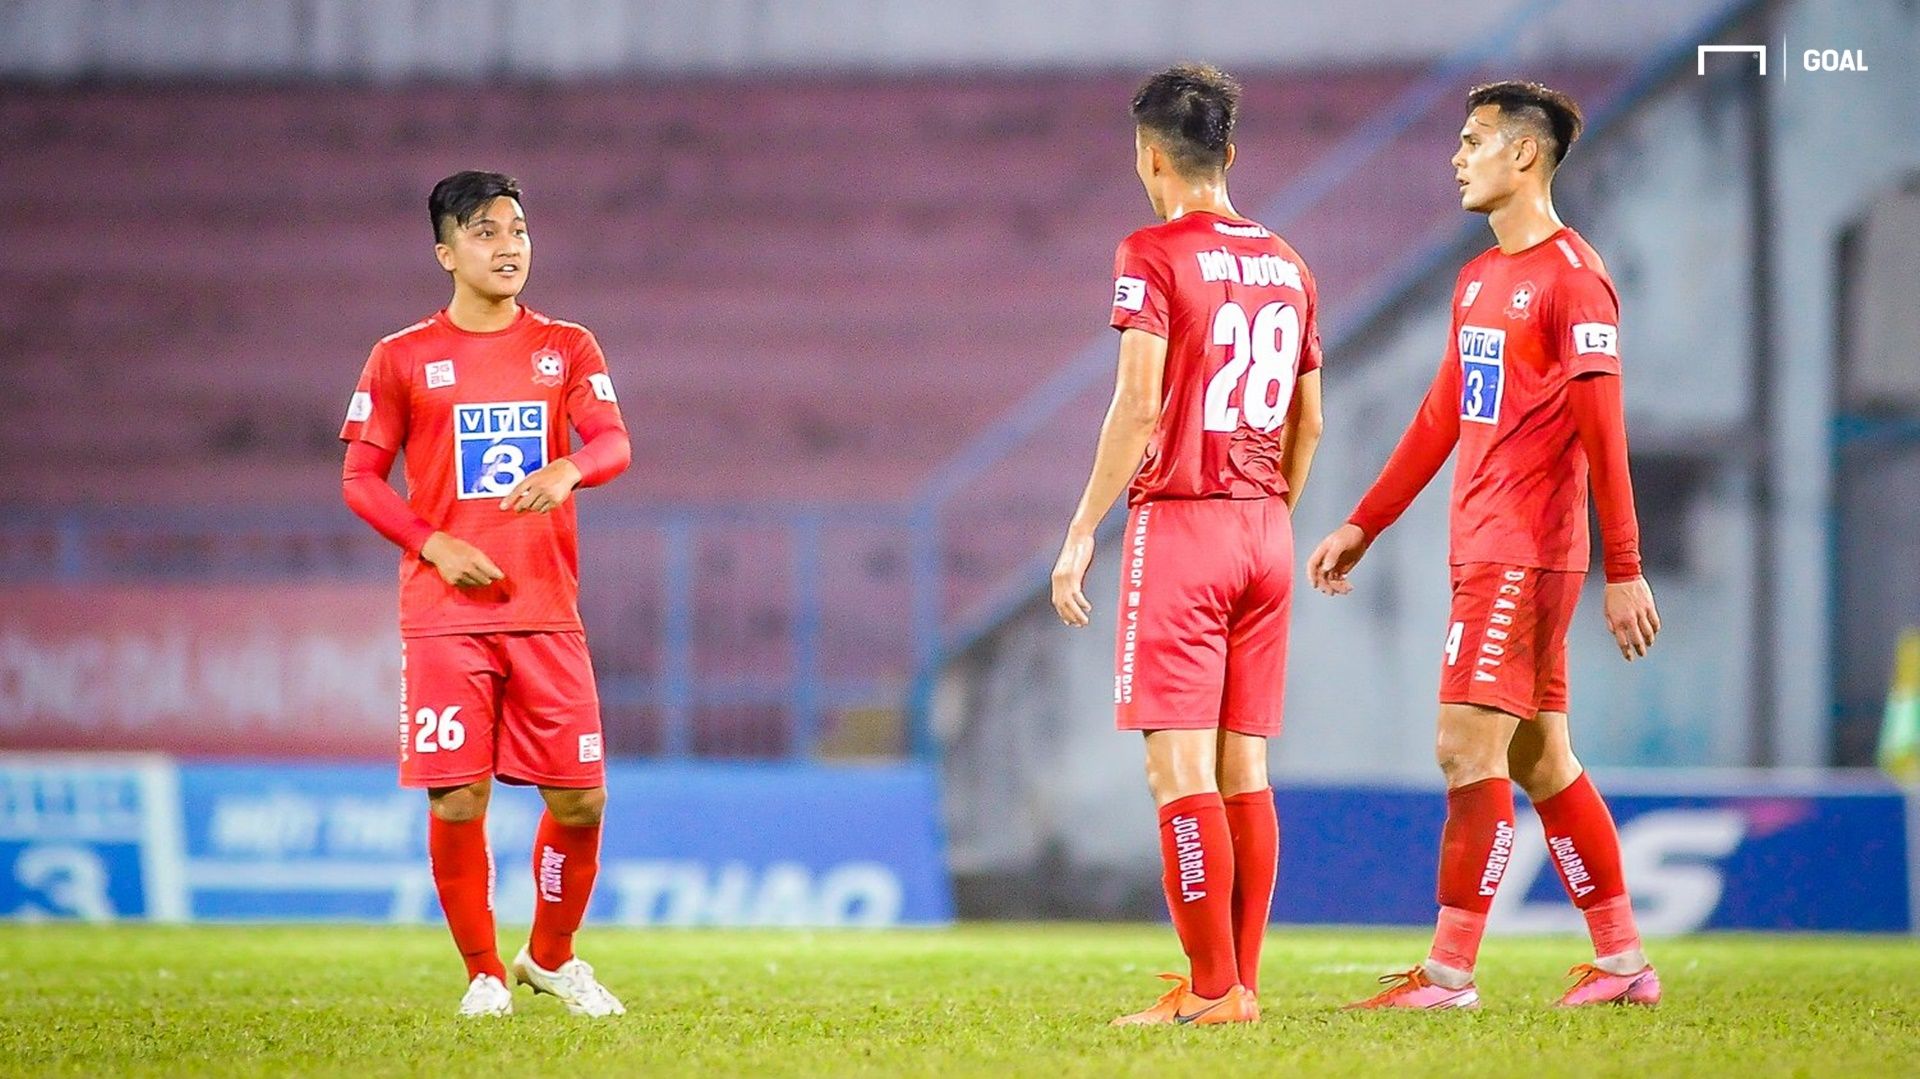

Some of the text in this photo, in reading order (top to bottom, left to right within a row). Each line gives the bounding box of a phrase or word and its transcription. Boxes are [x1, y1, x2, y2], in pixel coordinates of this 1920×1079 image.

[1203, 301, 1300, 433] 28
[1462, 331, 1500, 358] VTC
[1466, 369, 1484, 417] 3
[460, 410, 540, 431] VTC
[481, 444, 526, 494] 3
[1445, 621, 1465, 667] 4
[414, 705, 466, 753] 26
[1171, 815, 1207, 903] JOGARBOLA
[1478, 820, 1515, 897] JOGARBOLA
[1549, 835, 1596, 898] JOGARBOLA
